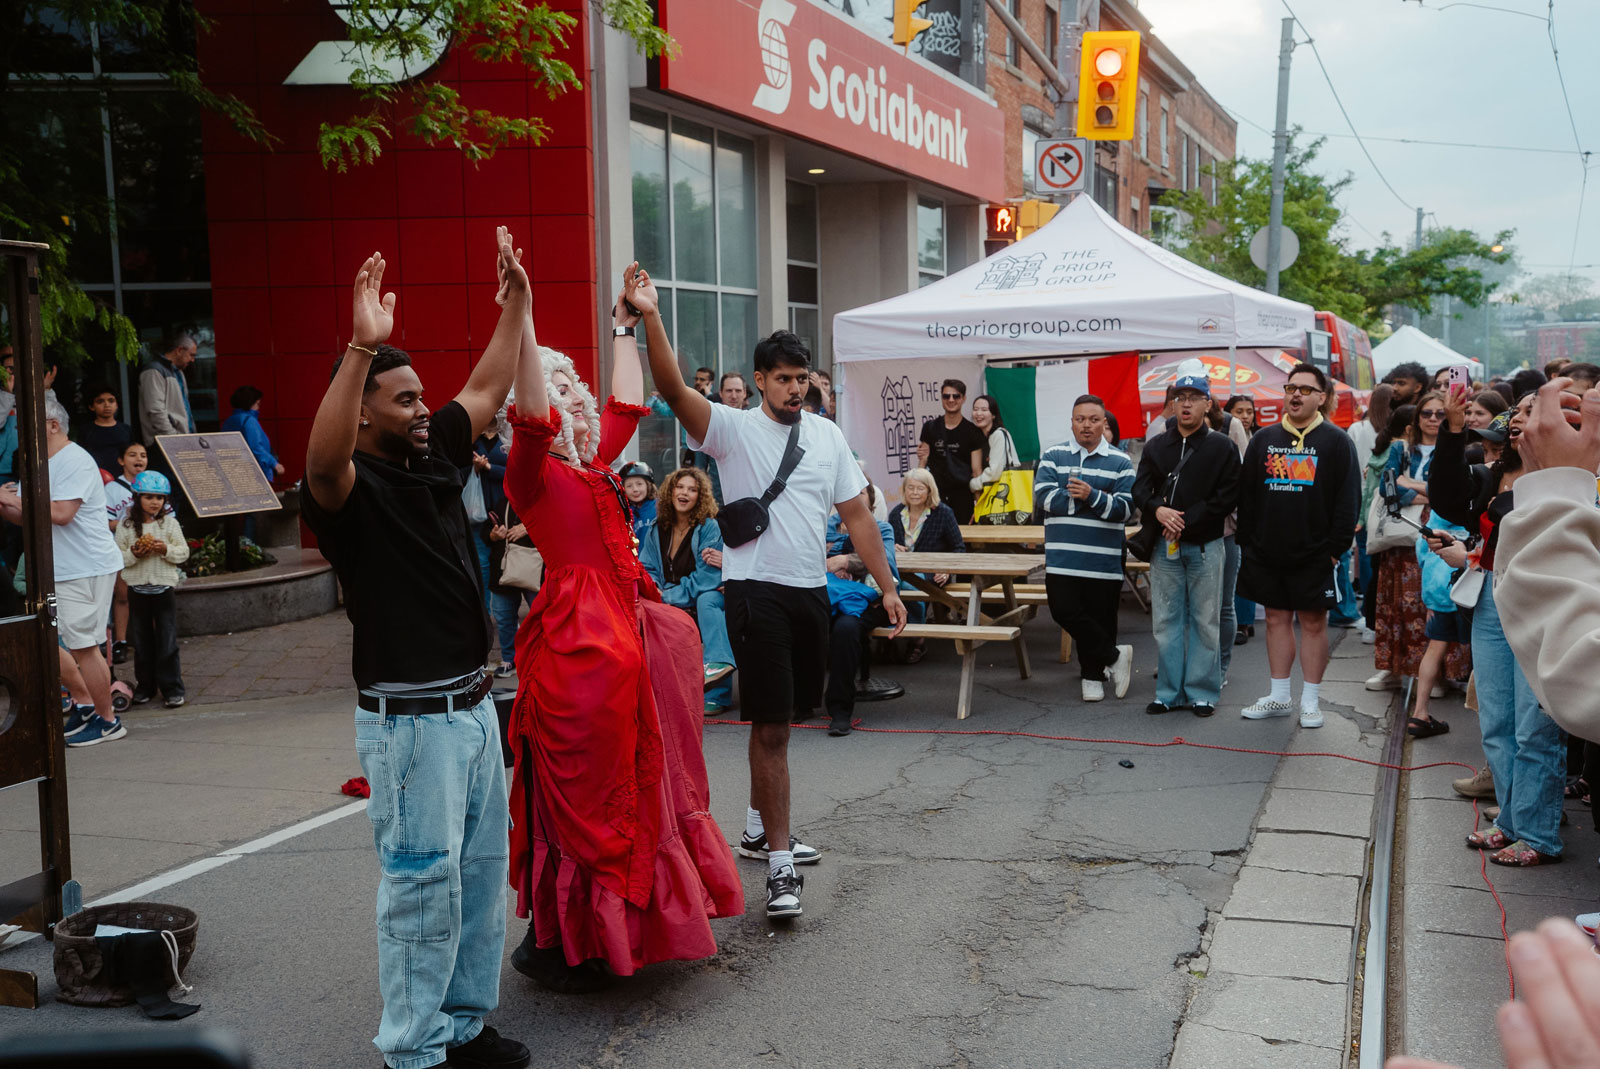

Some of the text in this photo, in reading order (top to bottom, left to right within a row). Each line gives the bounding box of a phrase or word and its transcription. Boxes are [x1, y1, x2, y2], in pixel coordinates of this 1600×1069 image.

[924, 35, 961, 56] 2022
[808, 38, 968, 168] Scotiabank
[1061, 249, 1100, 261] THE
[1052, 261, 1113, 273] PRIOR
[1045, 273, 1117, 286] GROUP
[926, 317, 1122, 341] thepriorgroup.com
[918, 381, 939, 402] THE
